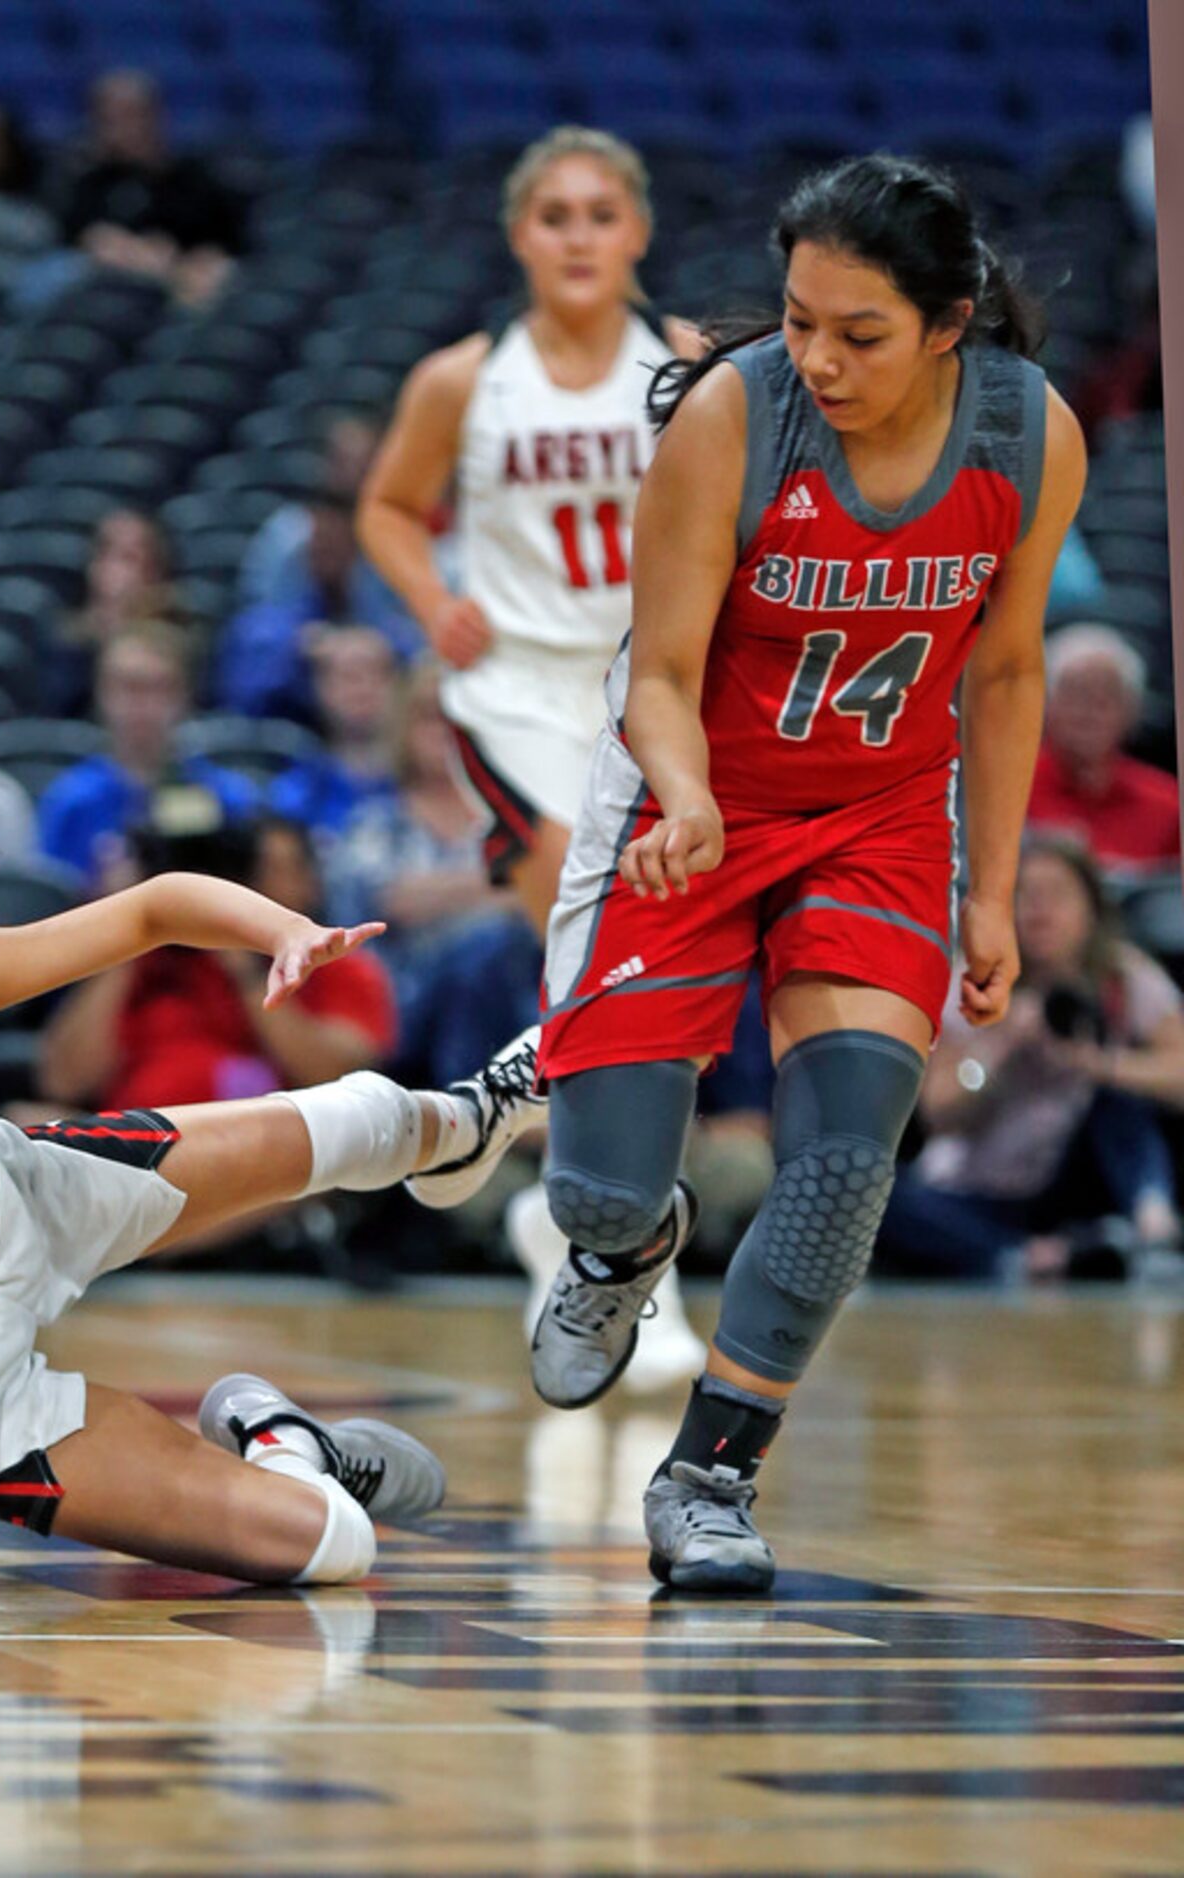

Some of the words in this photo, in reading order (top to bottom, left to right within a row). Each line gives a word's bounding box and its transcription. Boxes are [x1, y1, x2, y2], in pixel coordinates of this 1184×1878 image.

[552, 501, 630, 589] 11
[750, 554, 997, 611] BILLIES
[777, 629, 933, 747] 14
